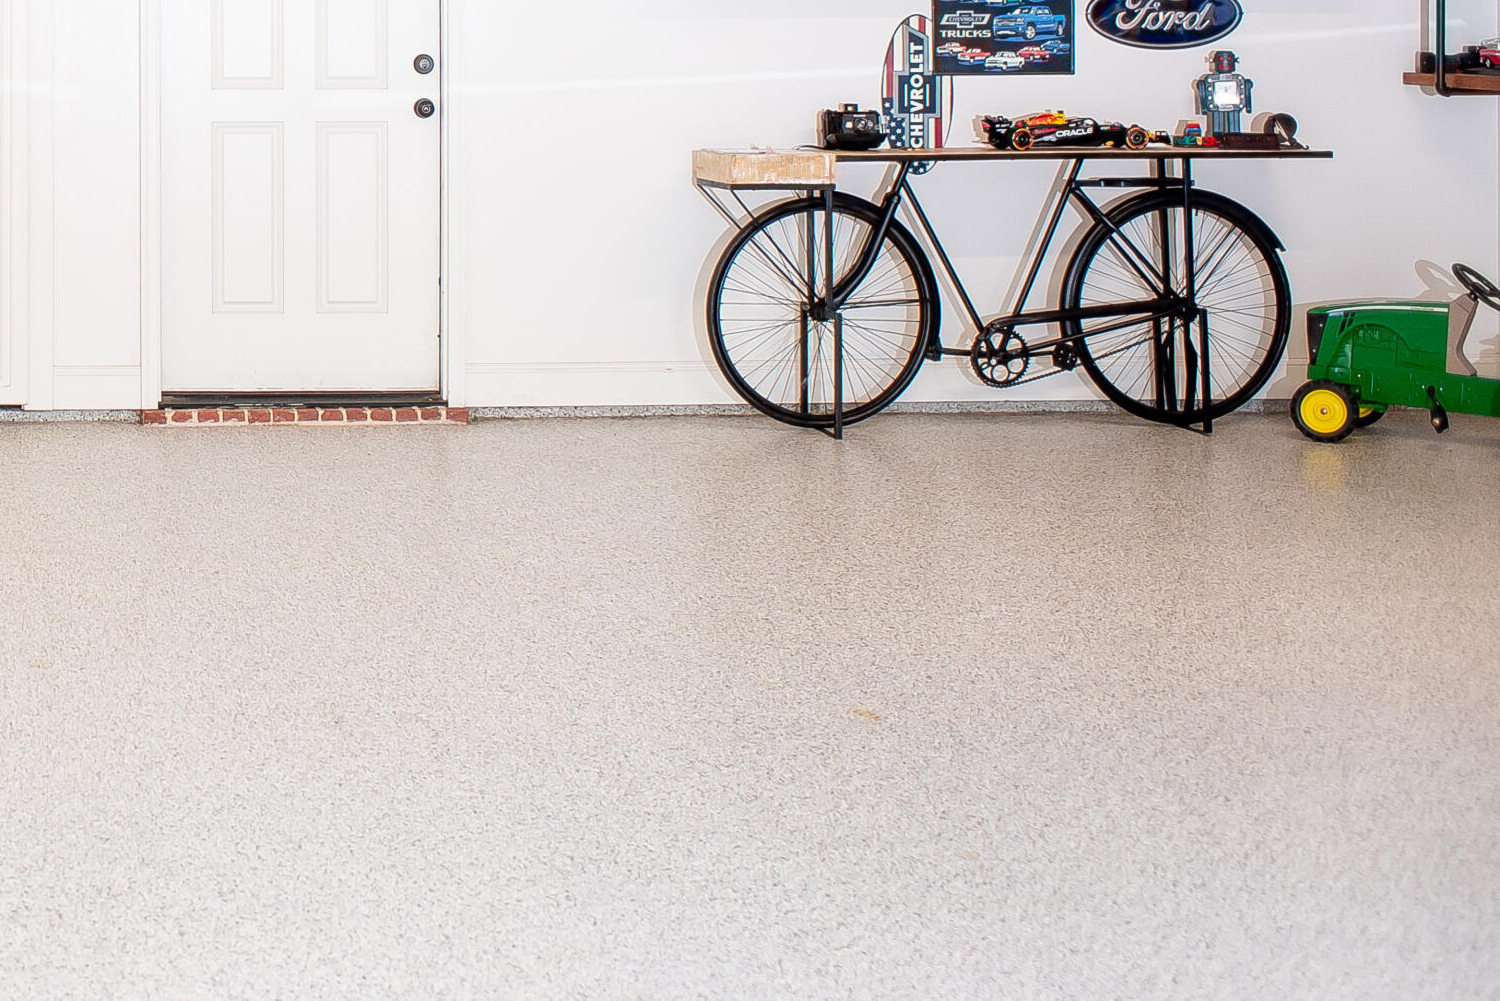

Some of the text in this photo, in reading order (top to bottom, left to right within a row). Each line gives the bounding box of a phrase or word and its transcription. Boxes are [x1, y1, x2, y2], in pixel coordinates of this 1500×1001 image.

[940, 30, 991, 38] TRUCKS
[910, 42, 924, 149] CHEVROLET
[1055, 127, 1093, 138] ORACLE
